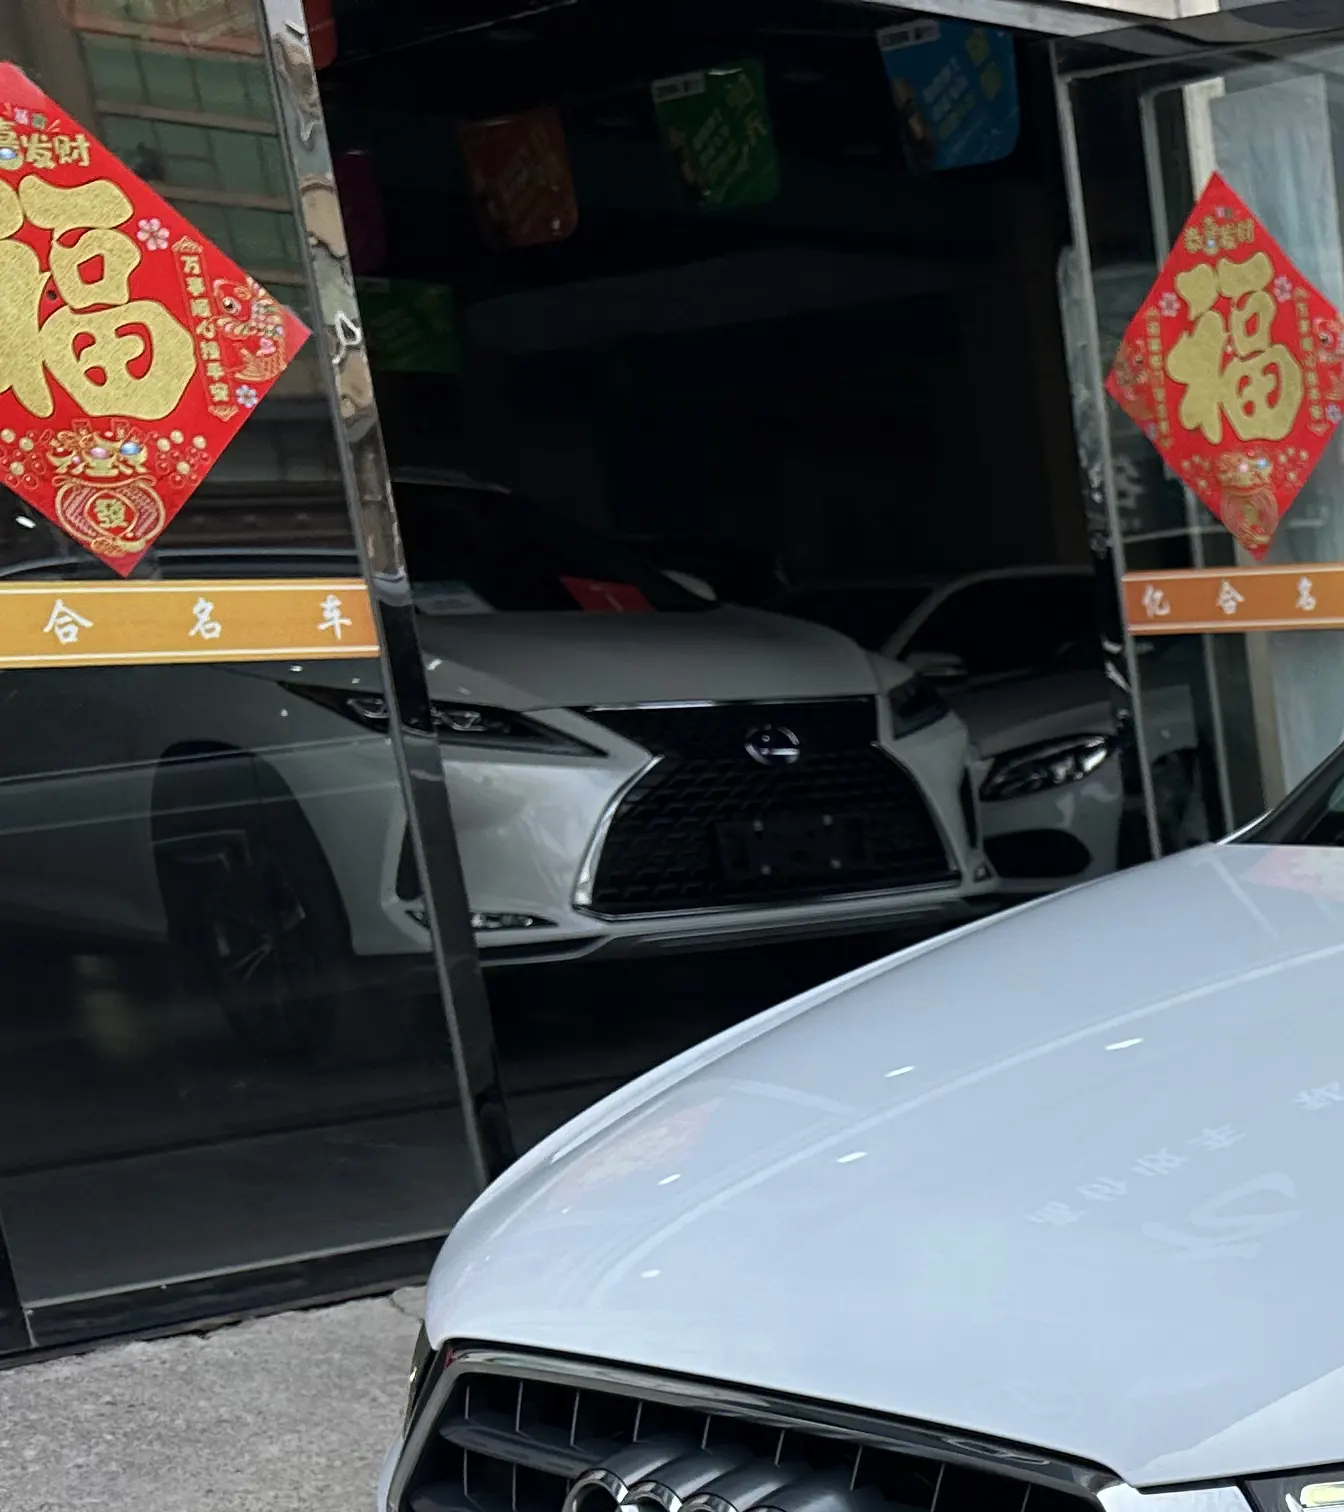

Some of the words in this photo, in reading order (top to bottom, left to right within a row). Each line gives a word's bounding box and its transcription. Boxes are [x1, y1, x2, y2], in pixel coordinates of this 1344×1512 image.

[1166, 252, 1304, 445] 福
[43, 594, 353, 645] 合名车
